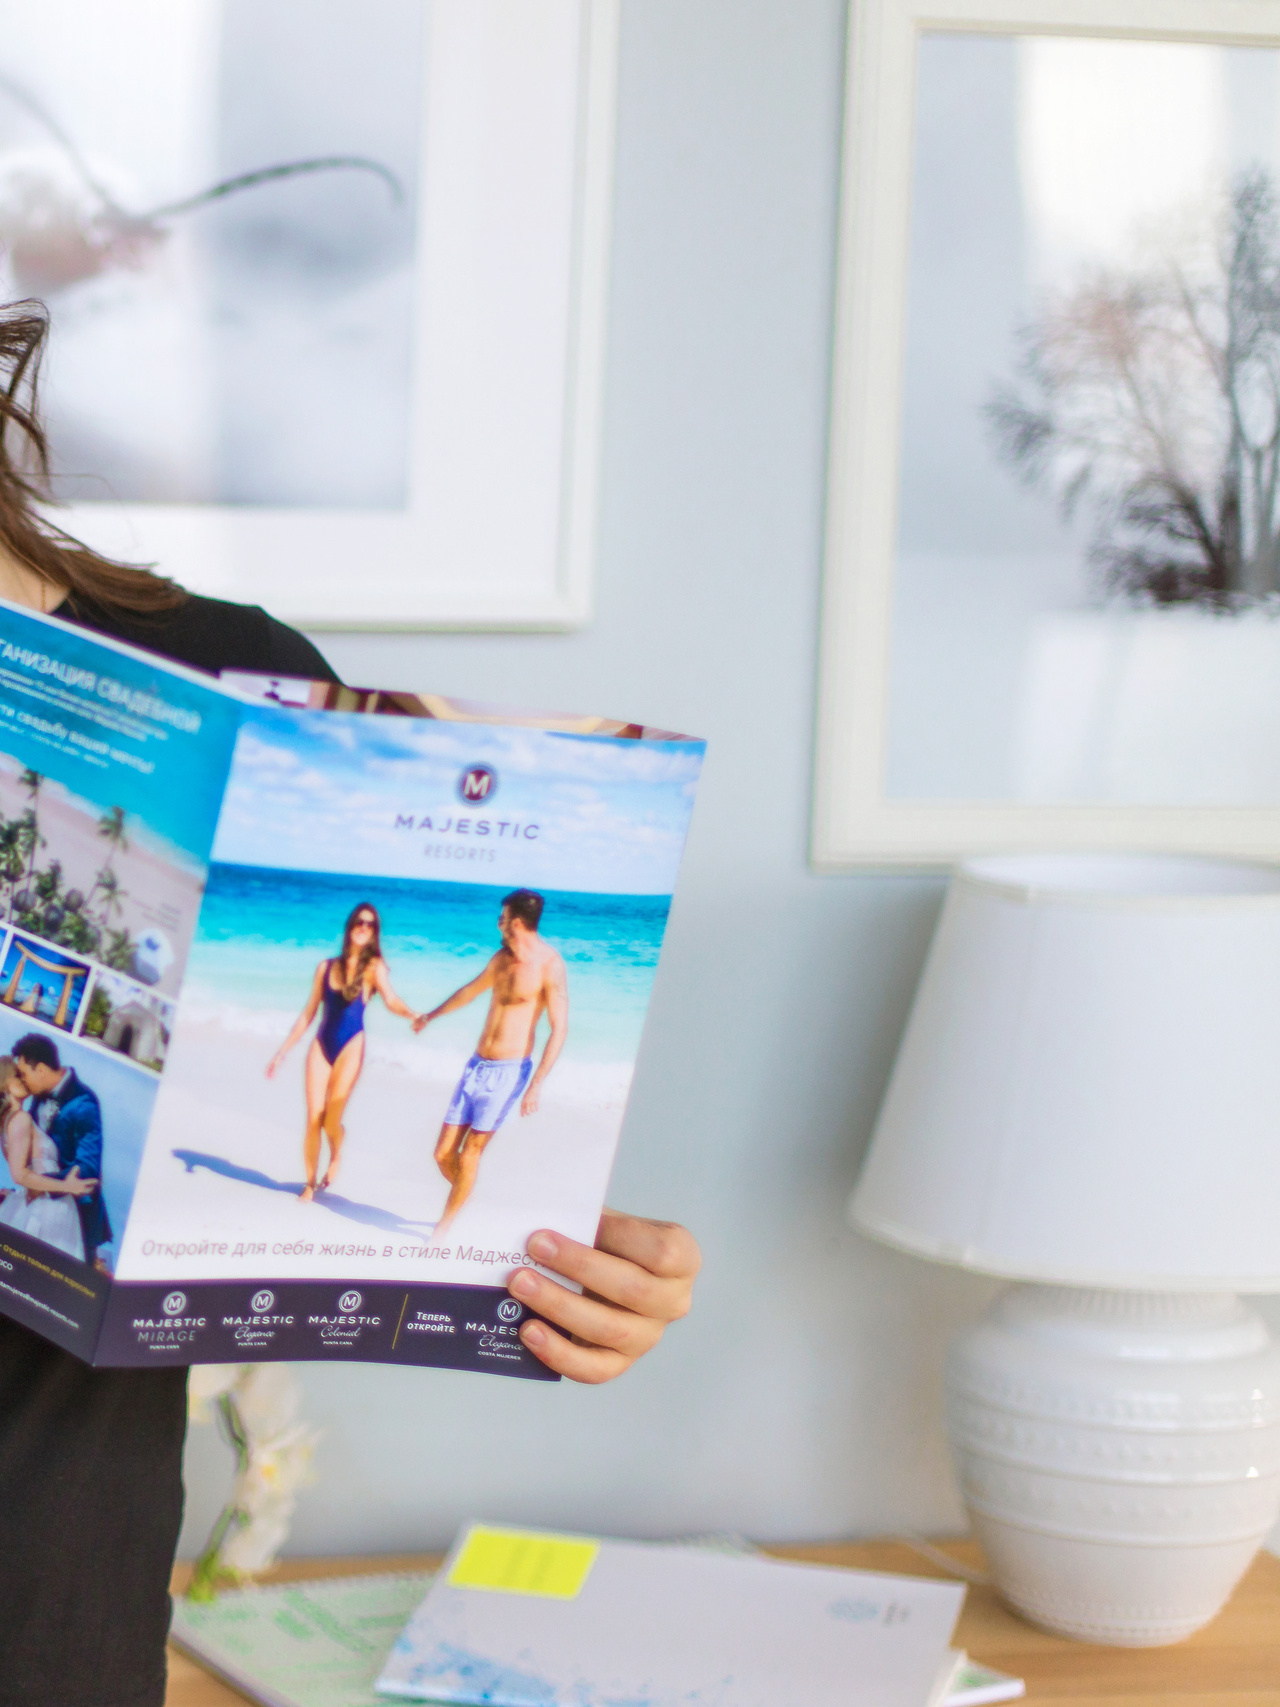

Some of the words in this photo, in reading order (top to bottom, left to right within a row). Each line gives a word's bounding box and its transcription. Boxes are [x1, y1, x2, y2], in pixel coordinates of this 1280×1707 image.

[15, 711, 67, 742] свадьбу
[394, 814, 540, 840] MAJESTIC
[423, 844, 496, 863] RESORTS
[142, 1240, 228, 1259] Откройте
[231, 1242, 267, 1258] для
[272, 1238, 314, 1256] себя
[319, 1243, 377, 1257] жизнь
[381, 1246, 393, 1257] в
[398, 1246, 451, 1260] стиле
[133, 1317, 206, 1328] MAJESTIC
[223, 1316, 294, 1325] MAJESTIC
[308, 1316, 381, 1325] MAJESTIC
[416, 1312, 451, 1323] ТЕПЕРЬ
[320, 1325, 361, 1338] Colonial
[407, 1322, 455, 1334] ОТКРОЙТЕ
[466, 1322, 518, 1336] MAJES
[137, 1330, 196, 1342] MIRAGE
